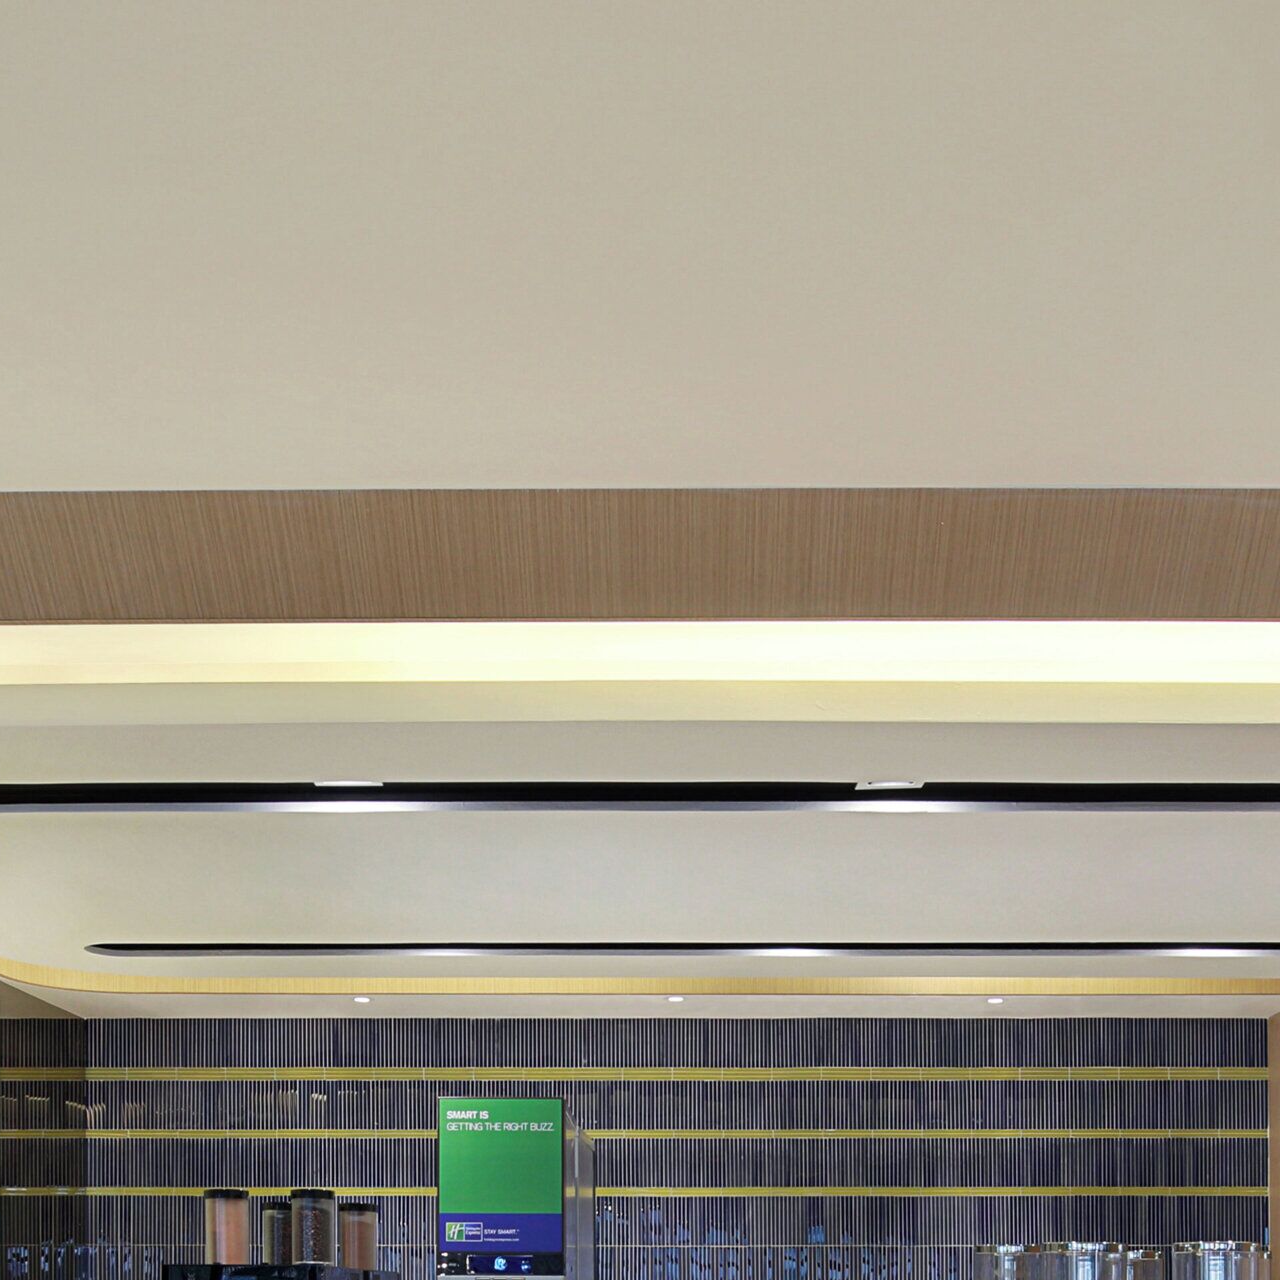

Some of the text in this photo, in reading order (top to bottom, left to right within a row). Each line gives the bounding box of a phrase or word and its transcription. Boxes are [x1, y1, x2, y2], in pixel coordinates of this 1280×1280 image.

[446, 1110, 489, 1120] SMART IS
[446, 1122, 483, 1131] GETTING
[485, 1122, 501, 1131] THE
[503, 1122, 528, 1131] RIGHT
